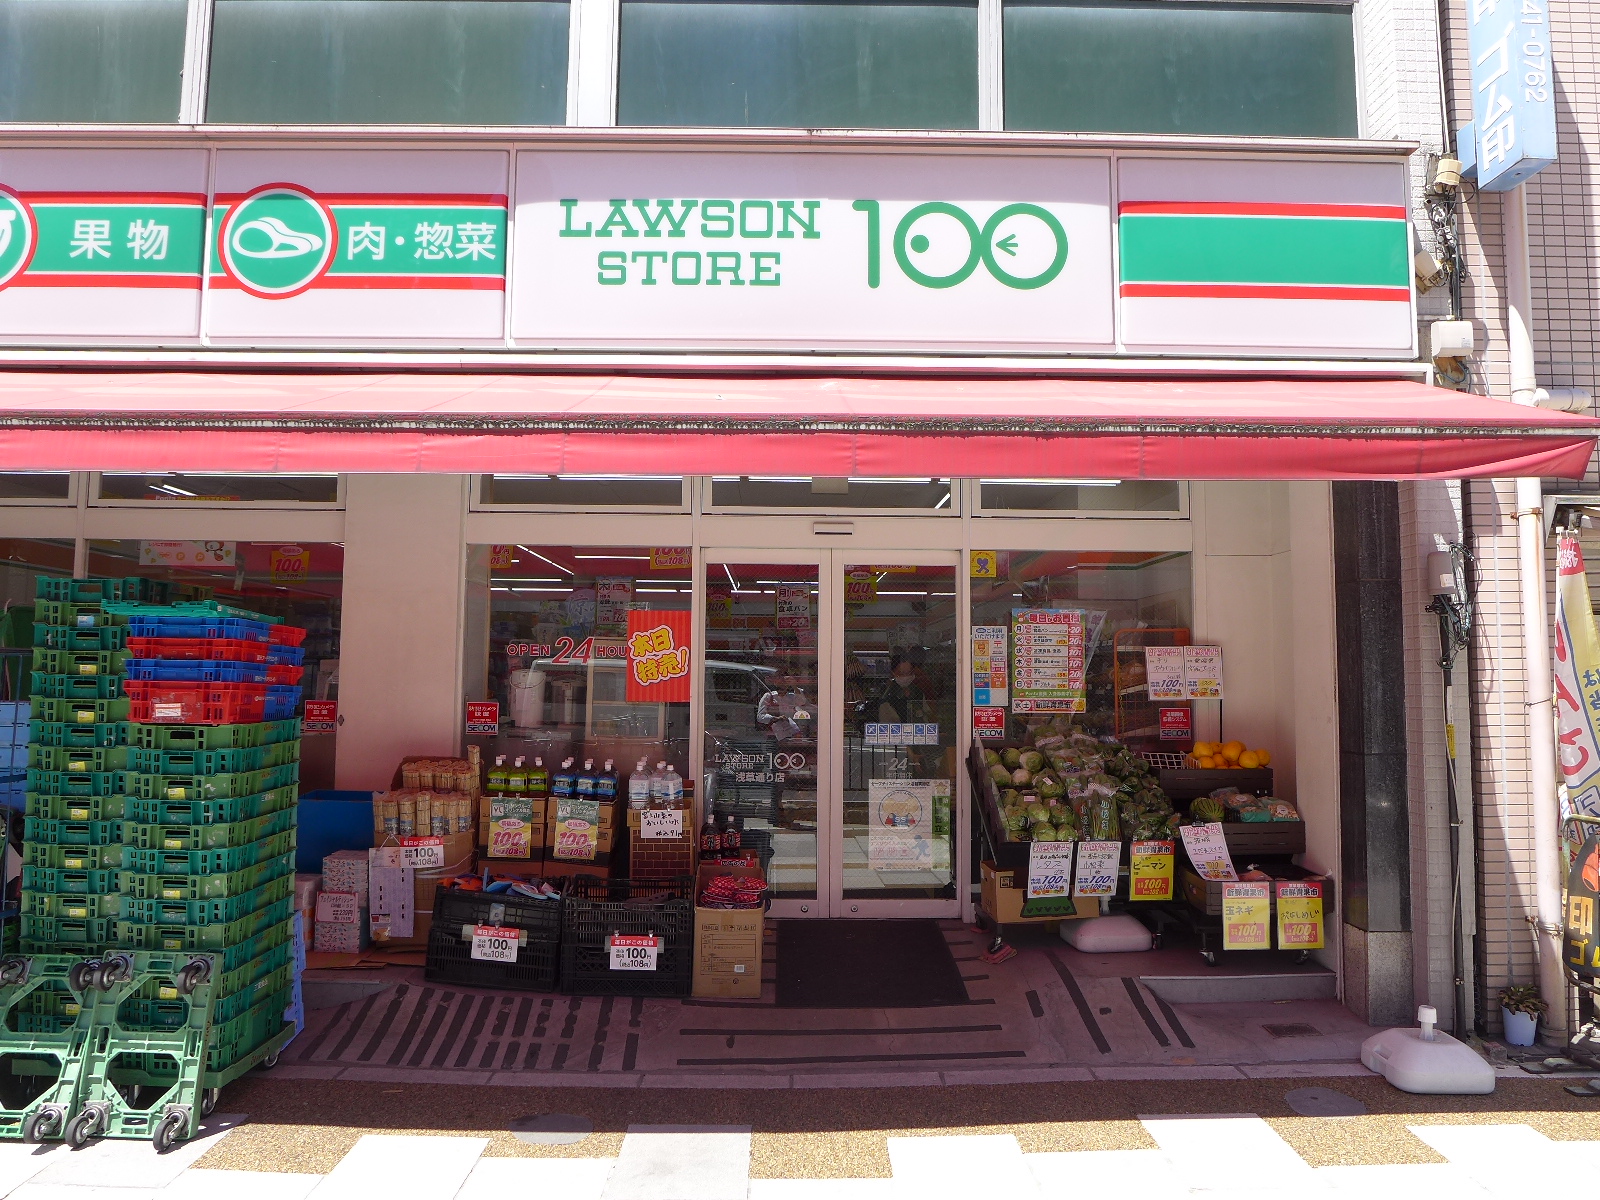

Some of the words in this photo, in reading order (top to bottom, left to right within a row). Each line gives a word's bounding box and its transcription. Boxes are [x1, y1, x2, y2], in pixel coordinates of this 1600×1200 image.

[1473, 0, 1515, 172] ゴム印
[559, 198, 821, 239] LAWSON
[69, 218, 170, 261] 果物
[346, 220, 498, 262] 肉・惣菜
[853, 199, 1069, 290] 100
[597, 250, 781, 287] STORE
[506, 643, 551, 657] OPEN
[551, 635, 596, 665] 24
[631, 626, 672, 657] 本日
[635, 648, 688, 683] 特売!
[306, 722, 334, 730] SECOM
[1161, 729, 1189, 737] SECOM
[714, 753, 765, 763] LAWSON
[725, 762, 754, 770] STORE
[766, 752, 806, 770] 100
[888, 757, 909, 771] 24
[735, 771, 785, 783] 浅草通り店
[1225, 906, 1254, 916] 玉ネギ
[1568, 895, 1594, 936] 印
